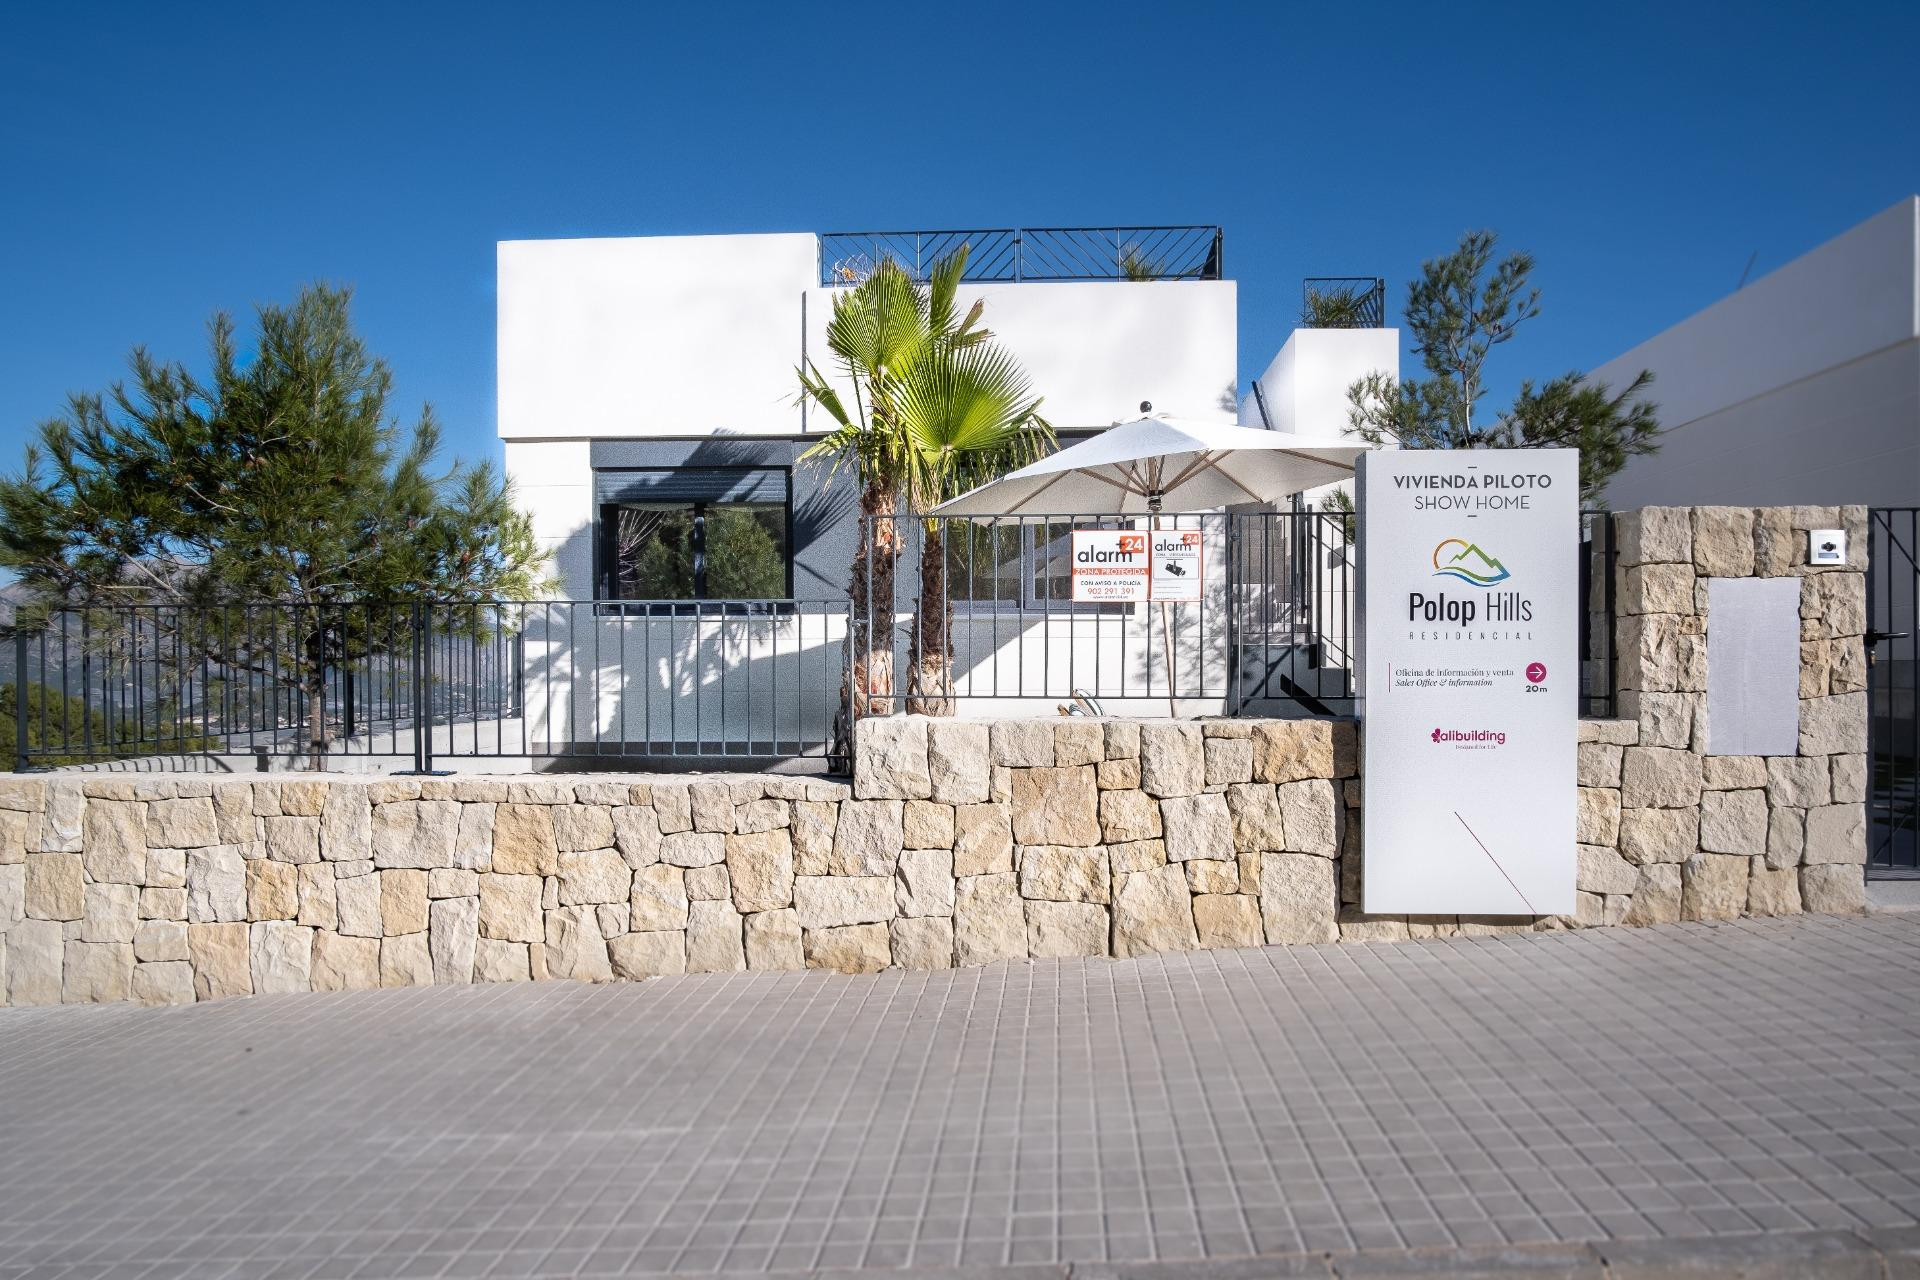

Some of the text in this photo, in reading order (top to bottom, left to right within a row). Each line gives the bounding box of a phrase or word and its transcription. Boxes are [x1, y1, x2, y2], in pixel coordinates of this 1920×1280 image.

[1393, 474, 1552, 489] VIVIENDA PILOTO
[1414, 495, 1530, 510] SHOW HOME
[1154, 538, 1192, 552] alarm
[1077, 544, 1133, 563] alarm
[1087, 587, 1102, 595] 902
[1409, 592, 1533, 627] Polop Hills
[1409, 631, 1532, 640] RESIDENCIAL
[1395, 668, 1424, 677] Oficina
[1425, 668, 1436, 677] de
[1437, 668, 1485, 677] información
[1492, 669, 1514, 677] venta
[1416, 678, 1438, 688] Office
[1448, 678, 1493, 688] information
[1440, 729, 1506, 745] alibuilding
